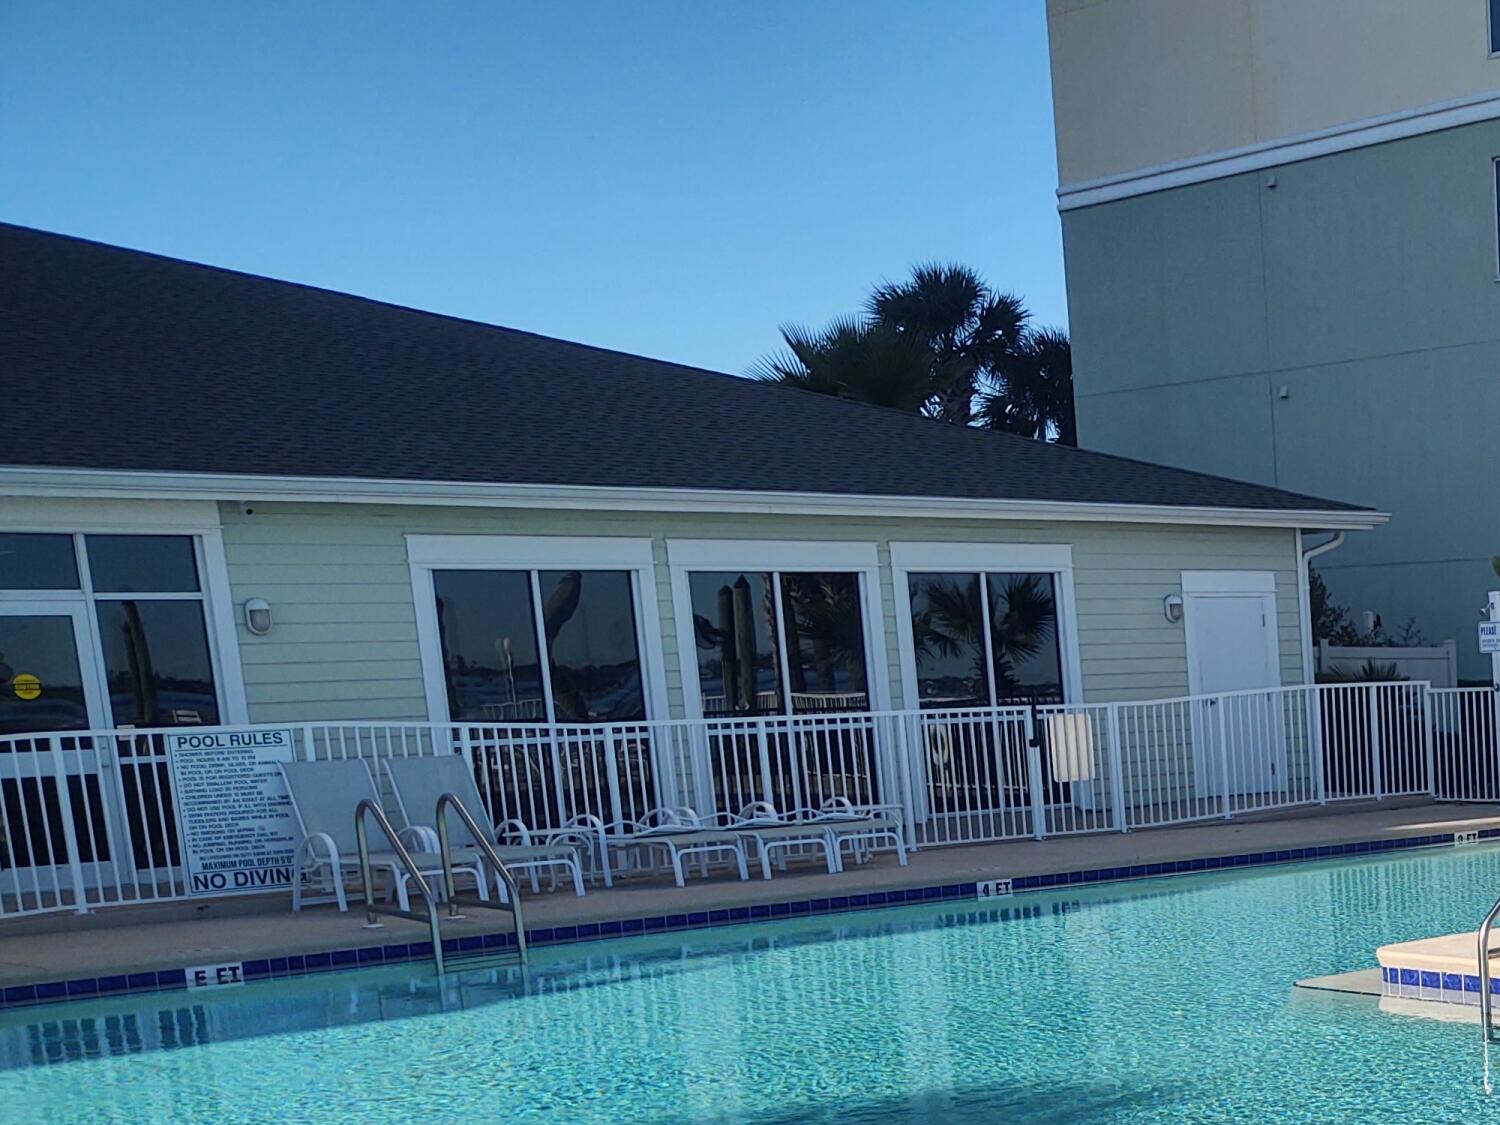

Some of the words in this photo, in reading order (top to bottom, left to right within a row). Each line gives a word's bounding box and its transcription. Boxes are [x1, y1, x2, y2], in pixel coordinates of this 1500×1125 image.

[176, 735, 225, 748] POOL
[229, 732, 283, 746] RULES
[201, 860, 237, 870] MAXIMUM
[237, 858, 256, 867] POOL
[256, 856, 279, 865] DEPTH
[193, 872, 227, 890] NO
